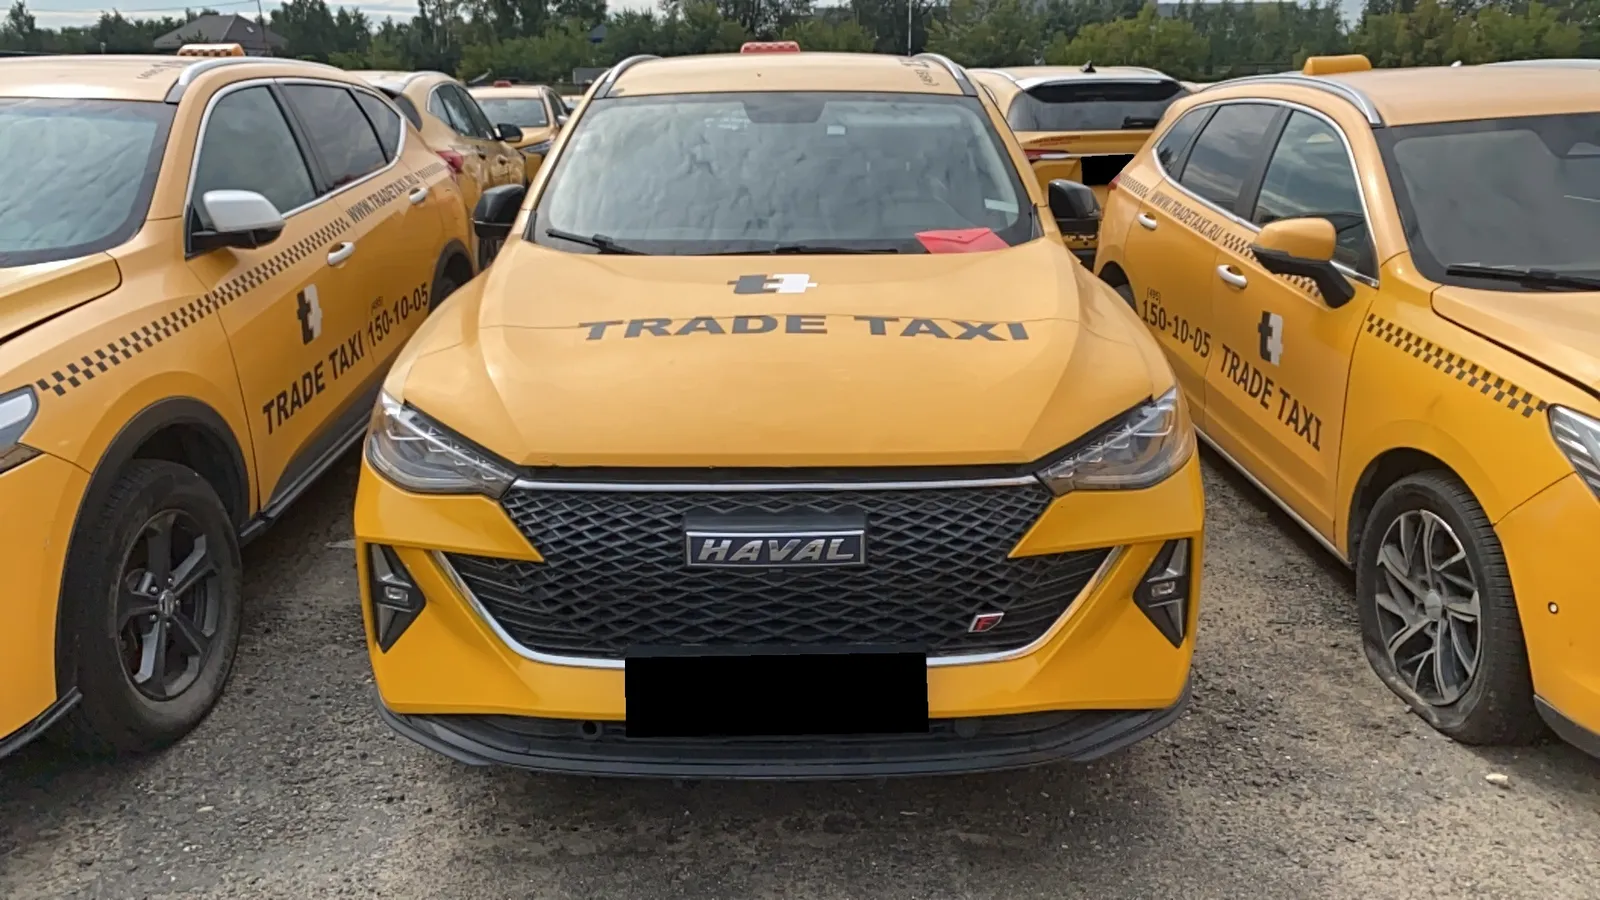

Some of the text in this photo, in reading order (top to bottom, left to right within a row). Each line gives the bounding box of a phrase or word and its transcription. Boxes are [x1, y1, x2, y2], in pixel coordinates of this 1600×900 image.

[345, 173, 419, 222] WWW.TRADETAXI.RU
[1150, 190, 1223, 242] WWW.TRADETAXI.RU
[367, 281, 429, 347] 150-10-05
[578, 314, 1030, 342] TRADE TAXI
[1142, 299, 1212, 358] 150-10-05
[262, 329, 364, 435] TRADE TAXI
[1220, 343, 1322, 452] TRADE TAXI
[697, 538, 855, 562] HAVAL
